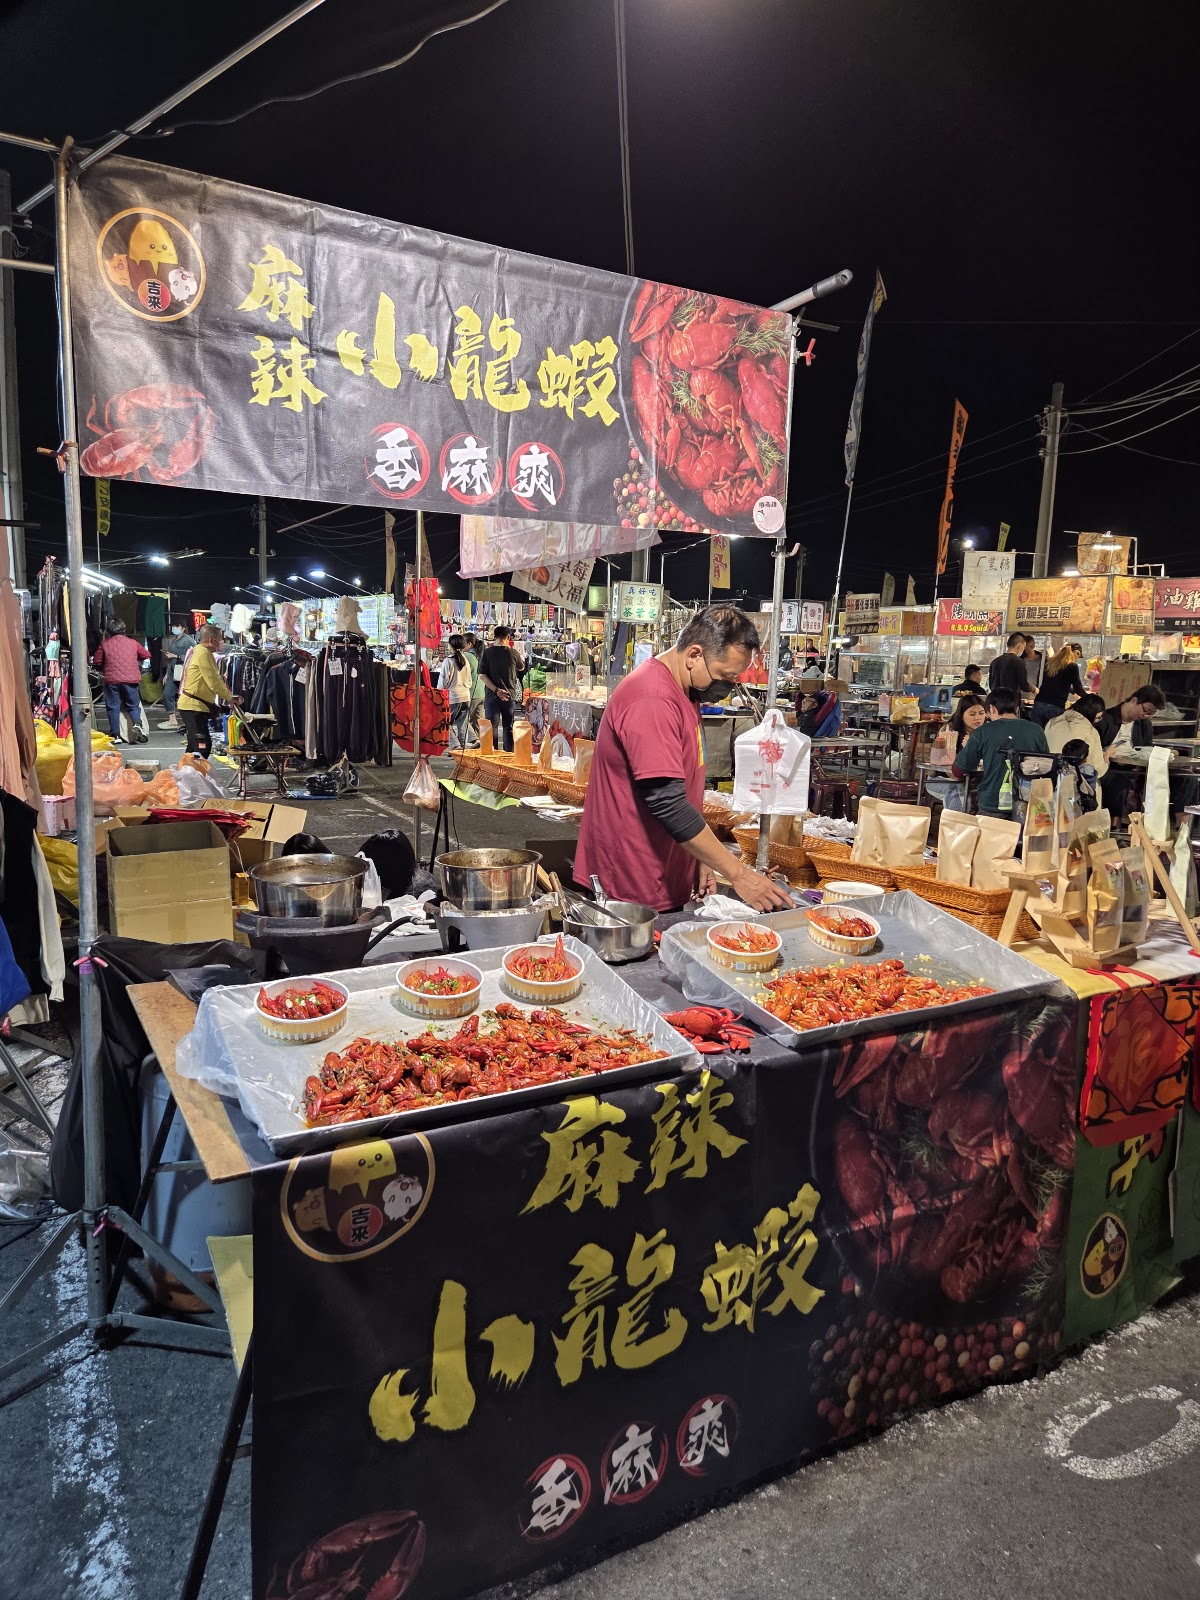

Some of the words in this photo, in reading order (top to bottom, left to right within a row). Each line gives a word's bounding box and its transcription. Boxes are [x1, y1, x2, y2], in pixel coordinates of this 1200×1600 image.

[236, 244, 329, 413] 麻辣
[336, 291, 621, 427] 小龍蝦
[366, 427, 557, 506] 香麻爽
[548, 575, 584, 605] 大福
[969, 623, 988, 633] Squid
[1015, 606, 1071, 620] 酥脆臭豆腐
[517, 1070, 749, 1217] 麻辣
[367, 1181, 826, 1443] 小龍蝦
[521, 1398, 731, 1538] 香麻爽
